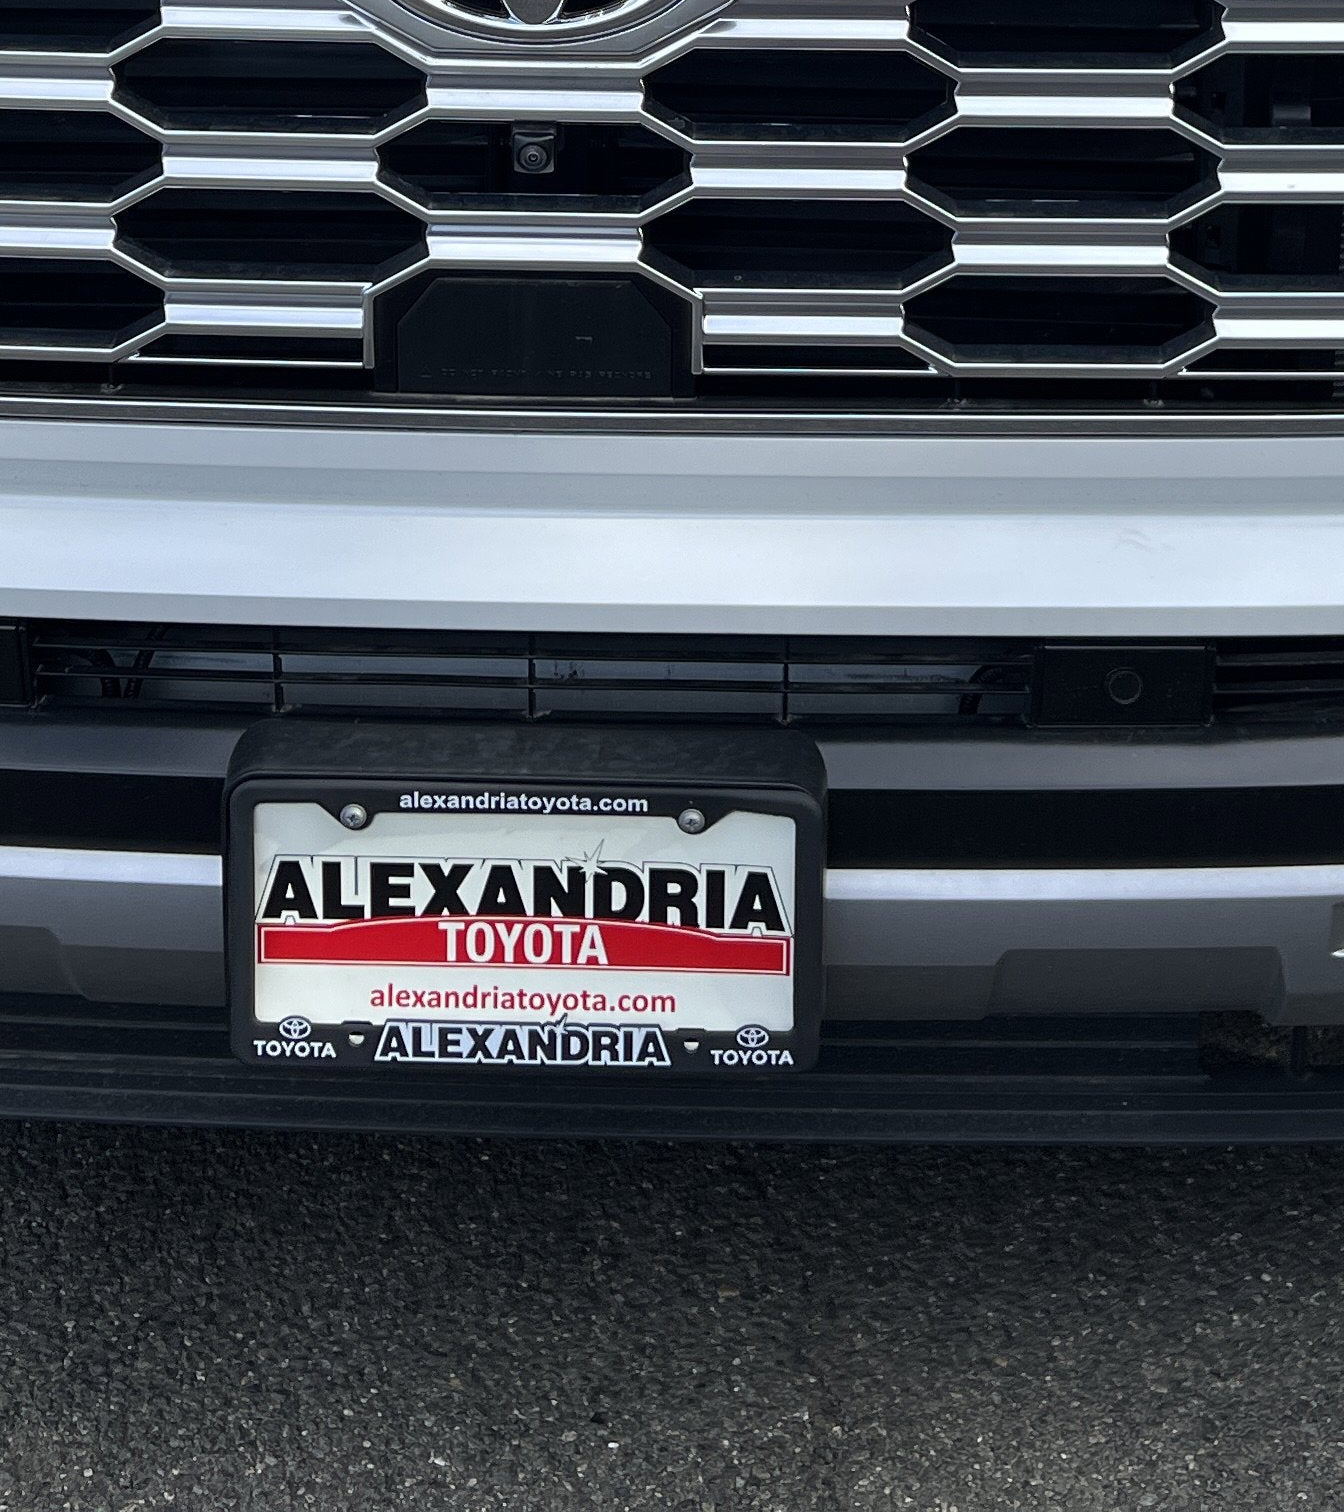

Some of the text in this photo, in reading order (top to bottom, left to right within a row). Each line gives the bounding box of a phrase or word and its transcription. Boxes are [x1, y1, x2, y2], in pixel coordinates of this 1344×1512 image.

[399, 791, 649, 814] alexandriatoyota.com
[262, 860, 789, 933] ALEXANDRIA
[438, 920, 609, 965] TOYOTA
[369, 984, 677, 1016] alexandriatoyota.com
[253, 1039, 337, 1060] TOYOTA
[374, 1020, 671, 1066] ALEXANDRIA
[711, 1048, 794, 1068] TOYOTA
